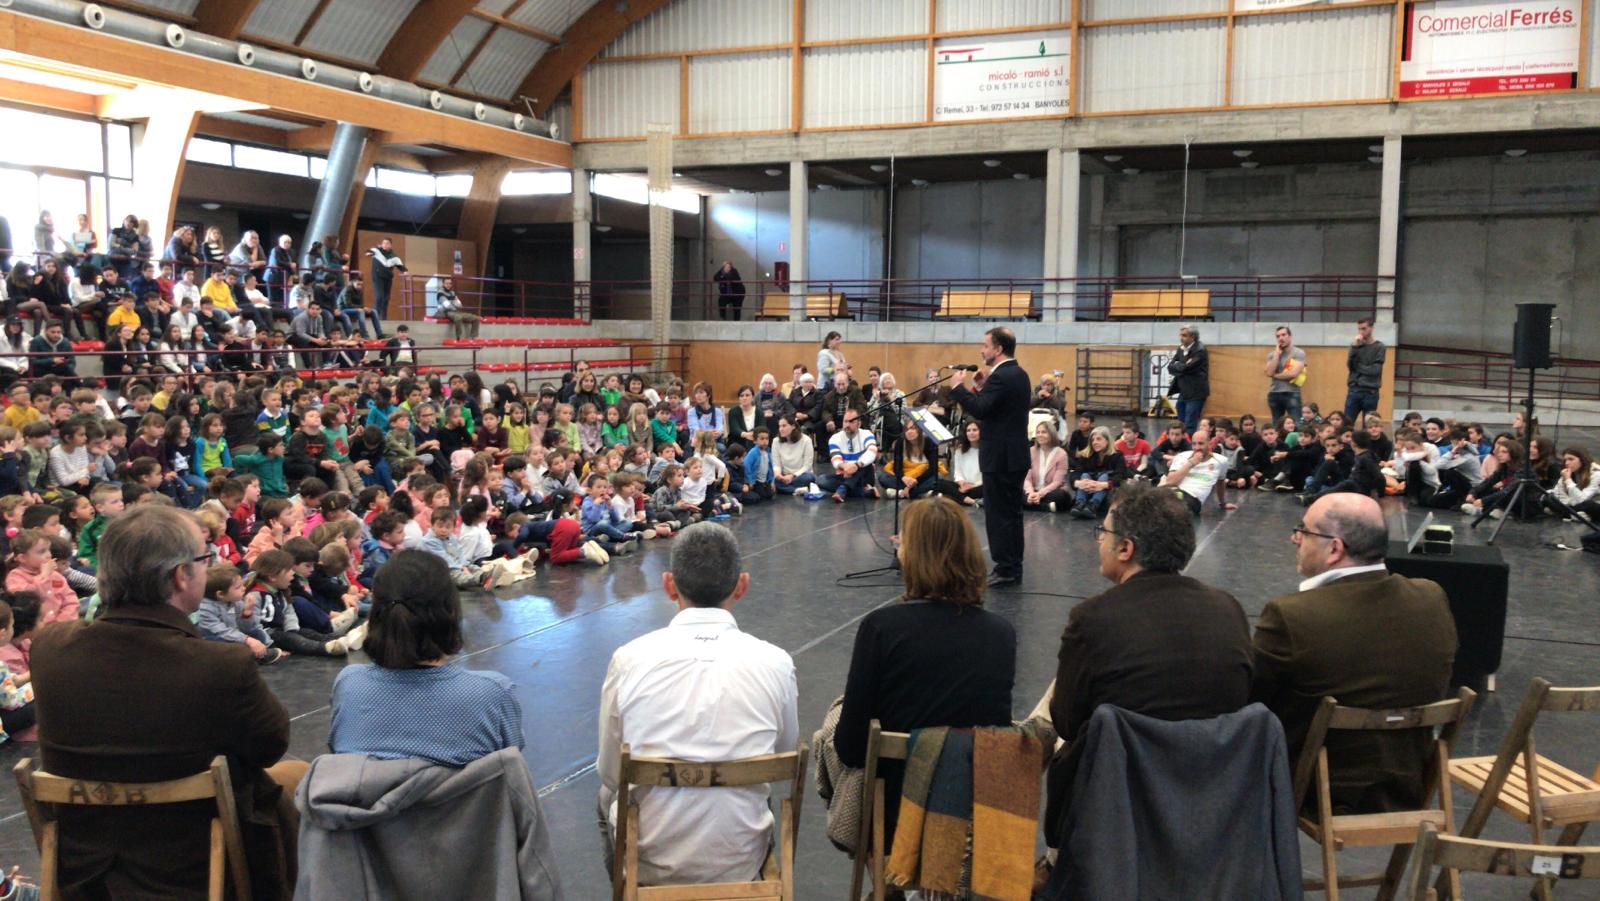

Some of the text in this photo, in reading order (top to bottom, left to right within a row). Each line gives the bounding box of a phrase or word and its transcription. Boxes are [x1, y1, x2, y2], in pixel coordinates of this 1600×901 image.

[1418, 10, 1508, 33] Comercial
[1510, 6, 1573, 26] Ferrés
[1024, 67, 1050, 78] ramió
[978, 79, 1070, 92] CONSTRUCCIONS
[1035, 98, 1070, 109] BANYOLES
[1561, 853, 1584, 879] B
